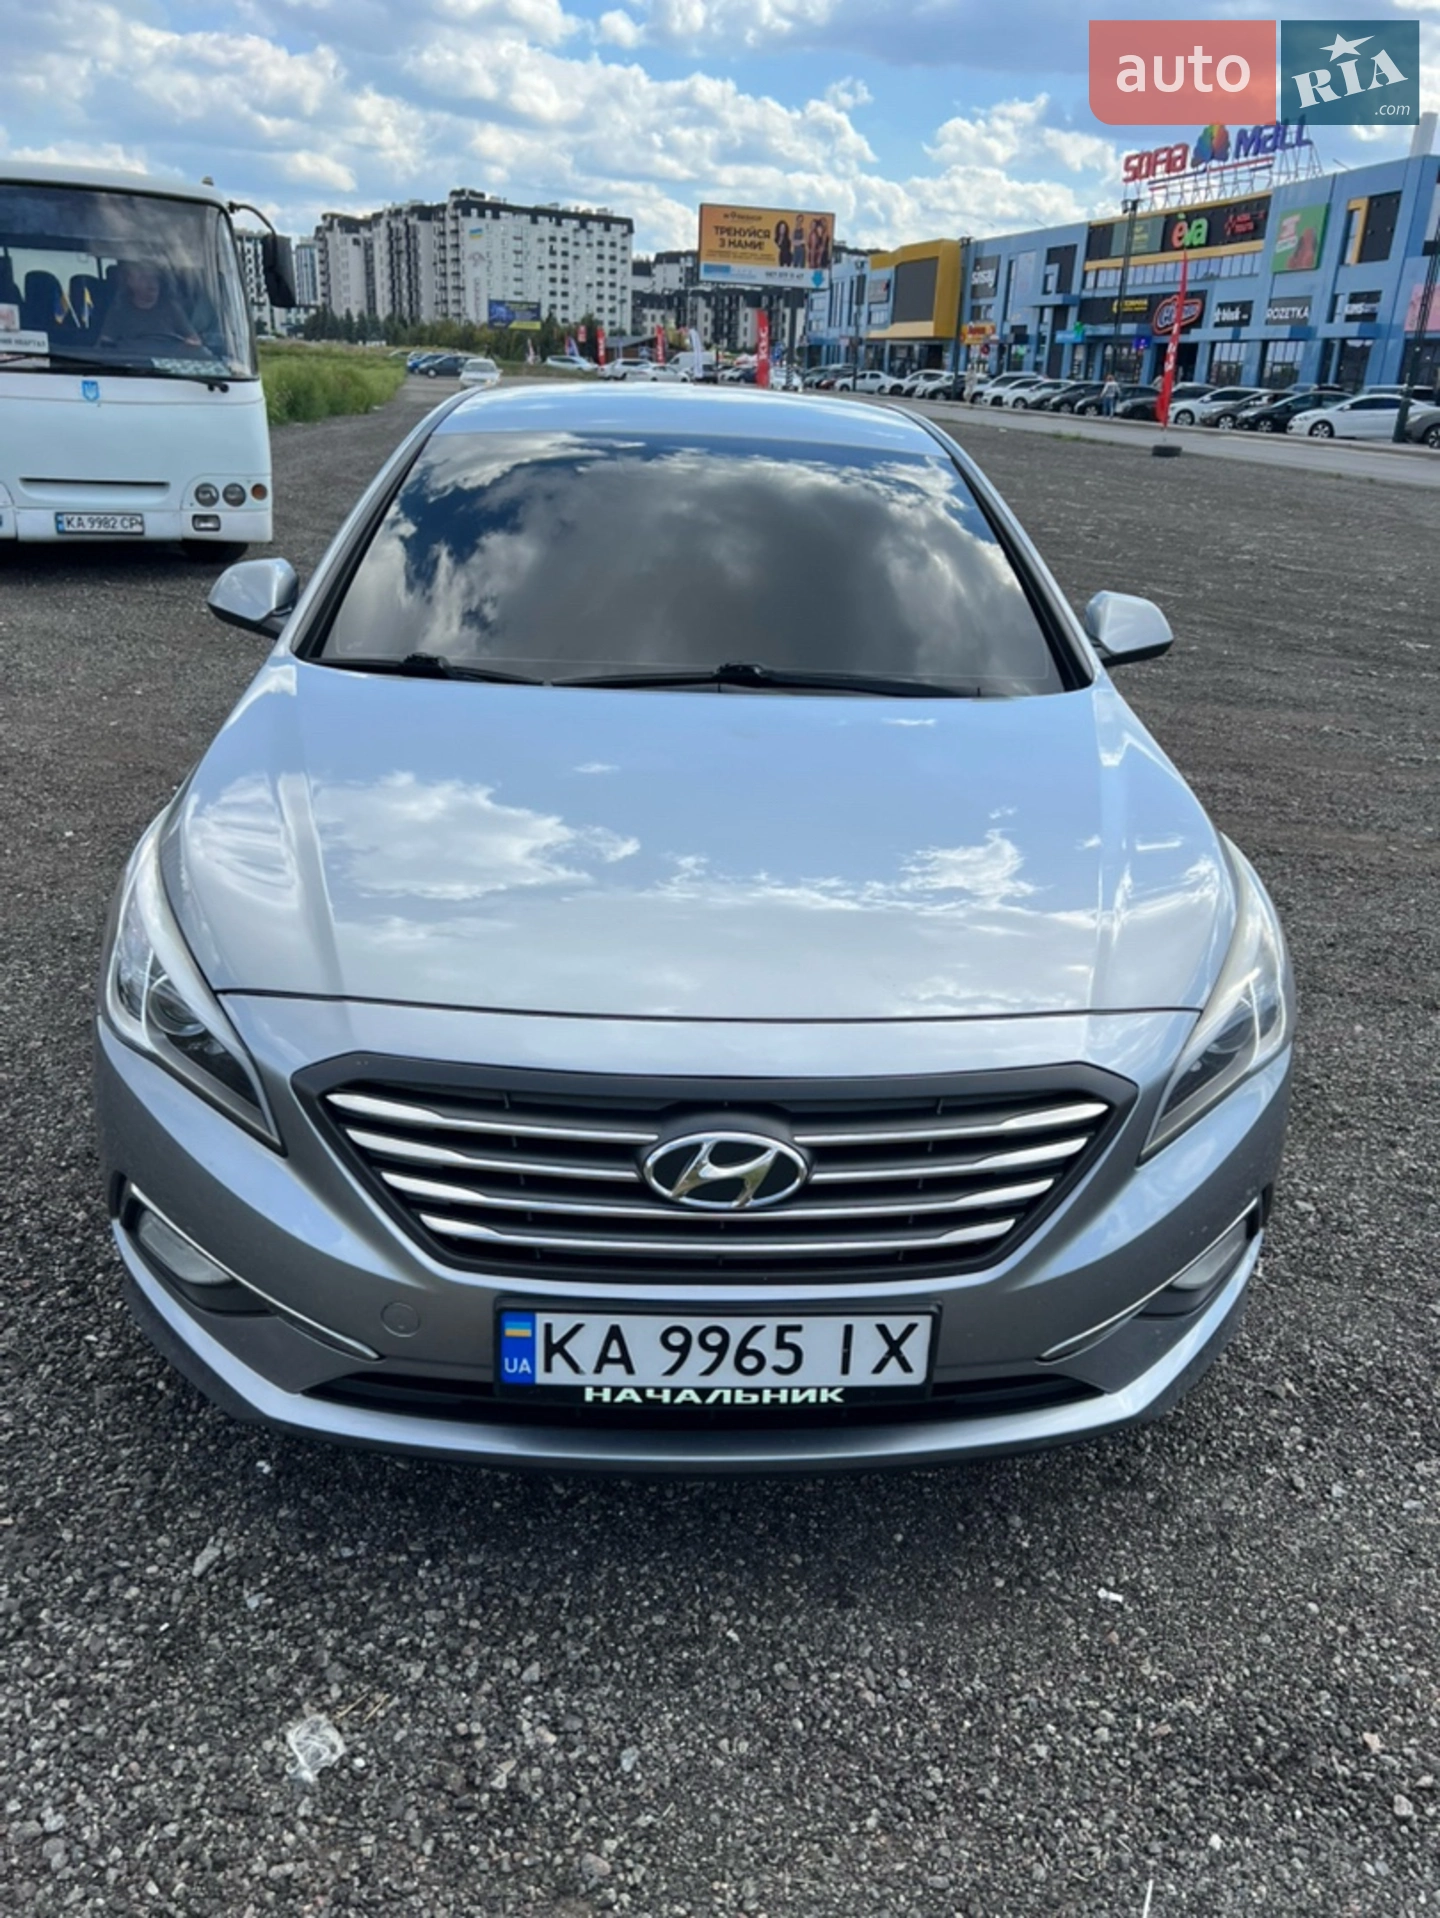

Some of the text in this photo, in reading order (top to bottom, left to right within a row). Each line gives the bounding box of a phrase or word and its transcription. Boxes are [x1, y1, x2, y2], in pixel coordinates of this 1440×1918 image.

[713, 225, 771, 239] ТРЕНУЙСЯ
[1266, 306, 1309, 320] ROZETKA
[65, 516, 86, 528] KA
[87, 517, 118, 529] 9982
[542, 1321, 919, 1377] KA 9965 IX
[504, 1356, 531, 1374] UA
[584, 1386, 845, 1405] НАЧАЛЬНИК
